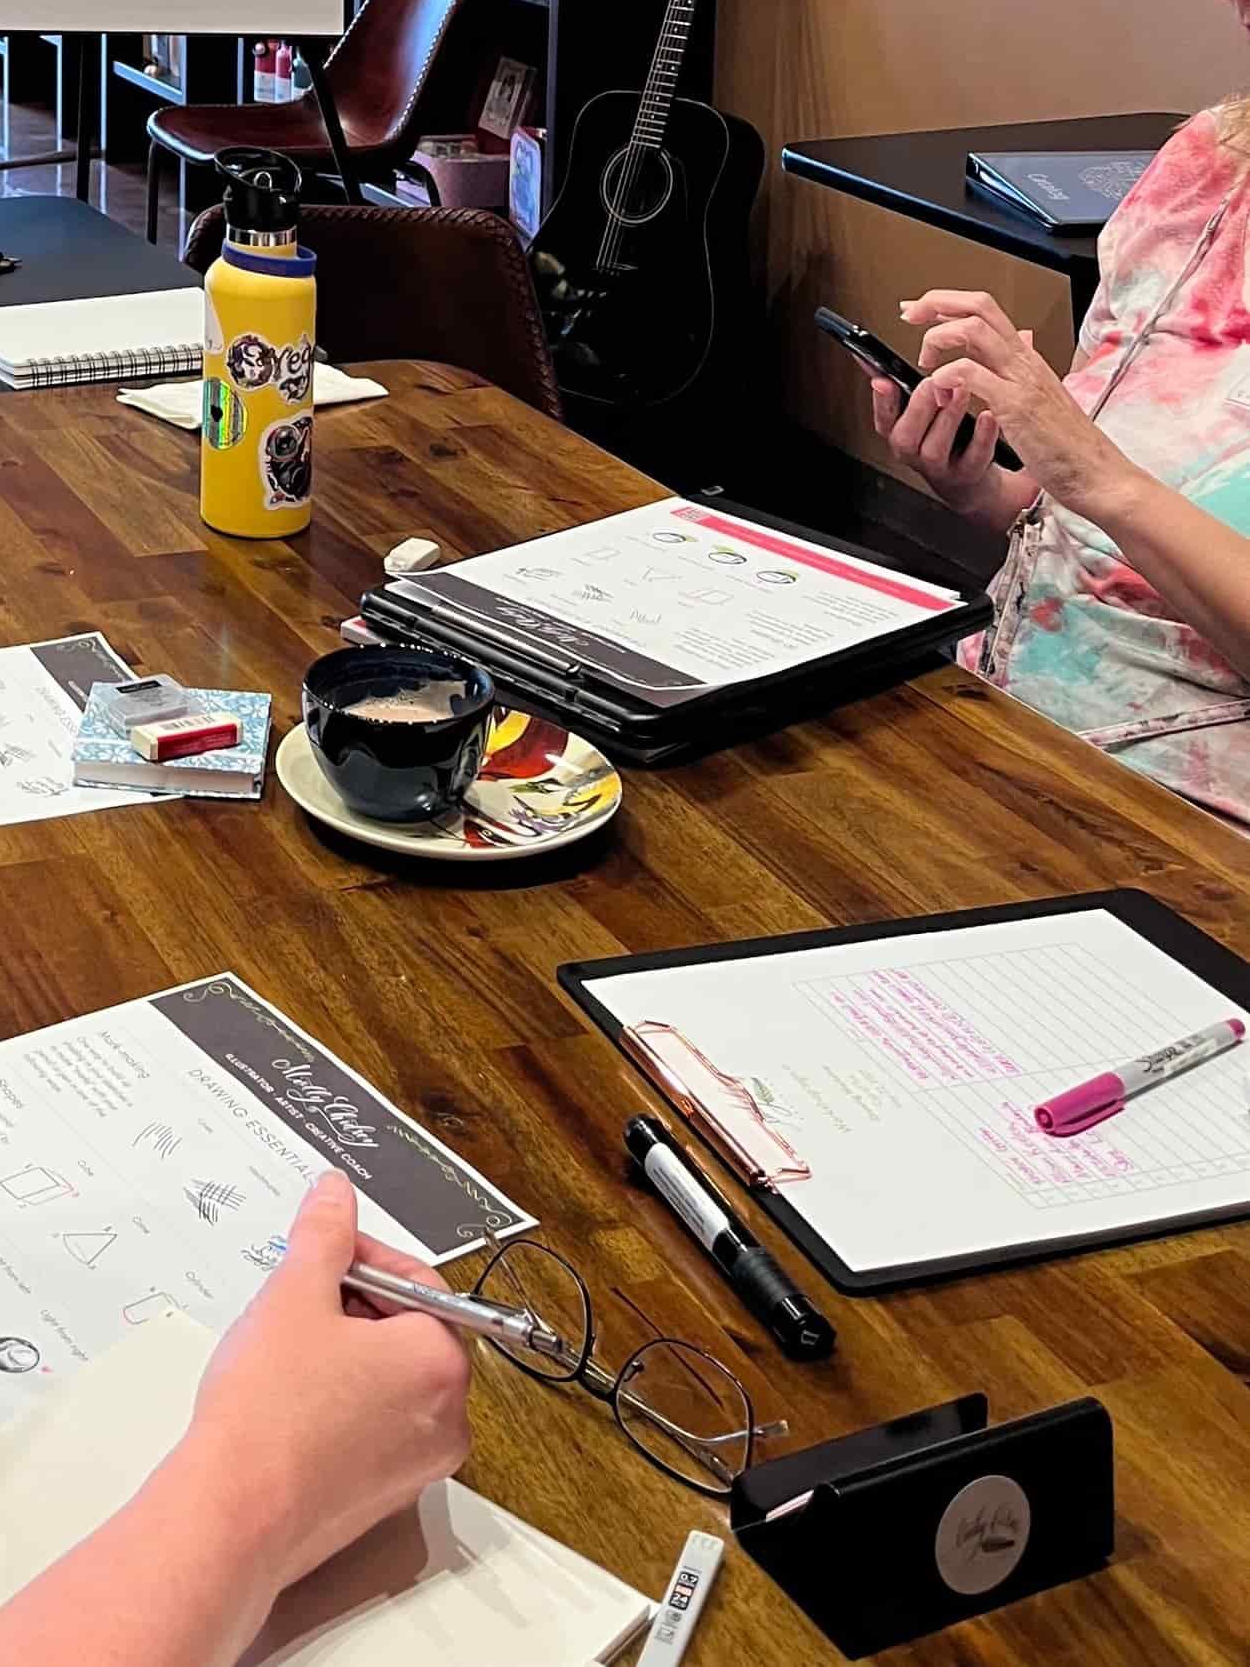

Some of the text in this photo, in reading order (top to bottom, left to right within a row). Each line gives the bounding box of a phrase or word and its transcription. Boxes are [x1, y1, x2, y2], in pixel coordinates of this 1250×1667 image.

[98, 1030, 150, 1078] Mark-making
[188, 1070, 248, 1118] DRAWING
[272, 1059, 342, 1109] Molly
[226, 1054, 372, 1179] ILLUSTRATOR ARTIST CREATIVE COACH
